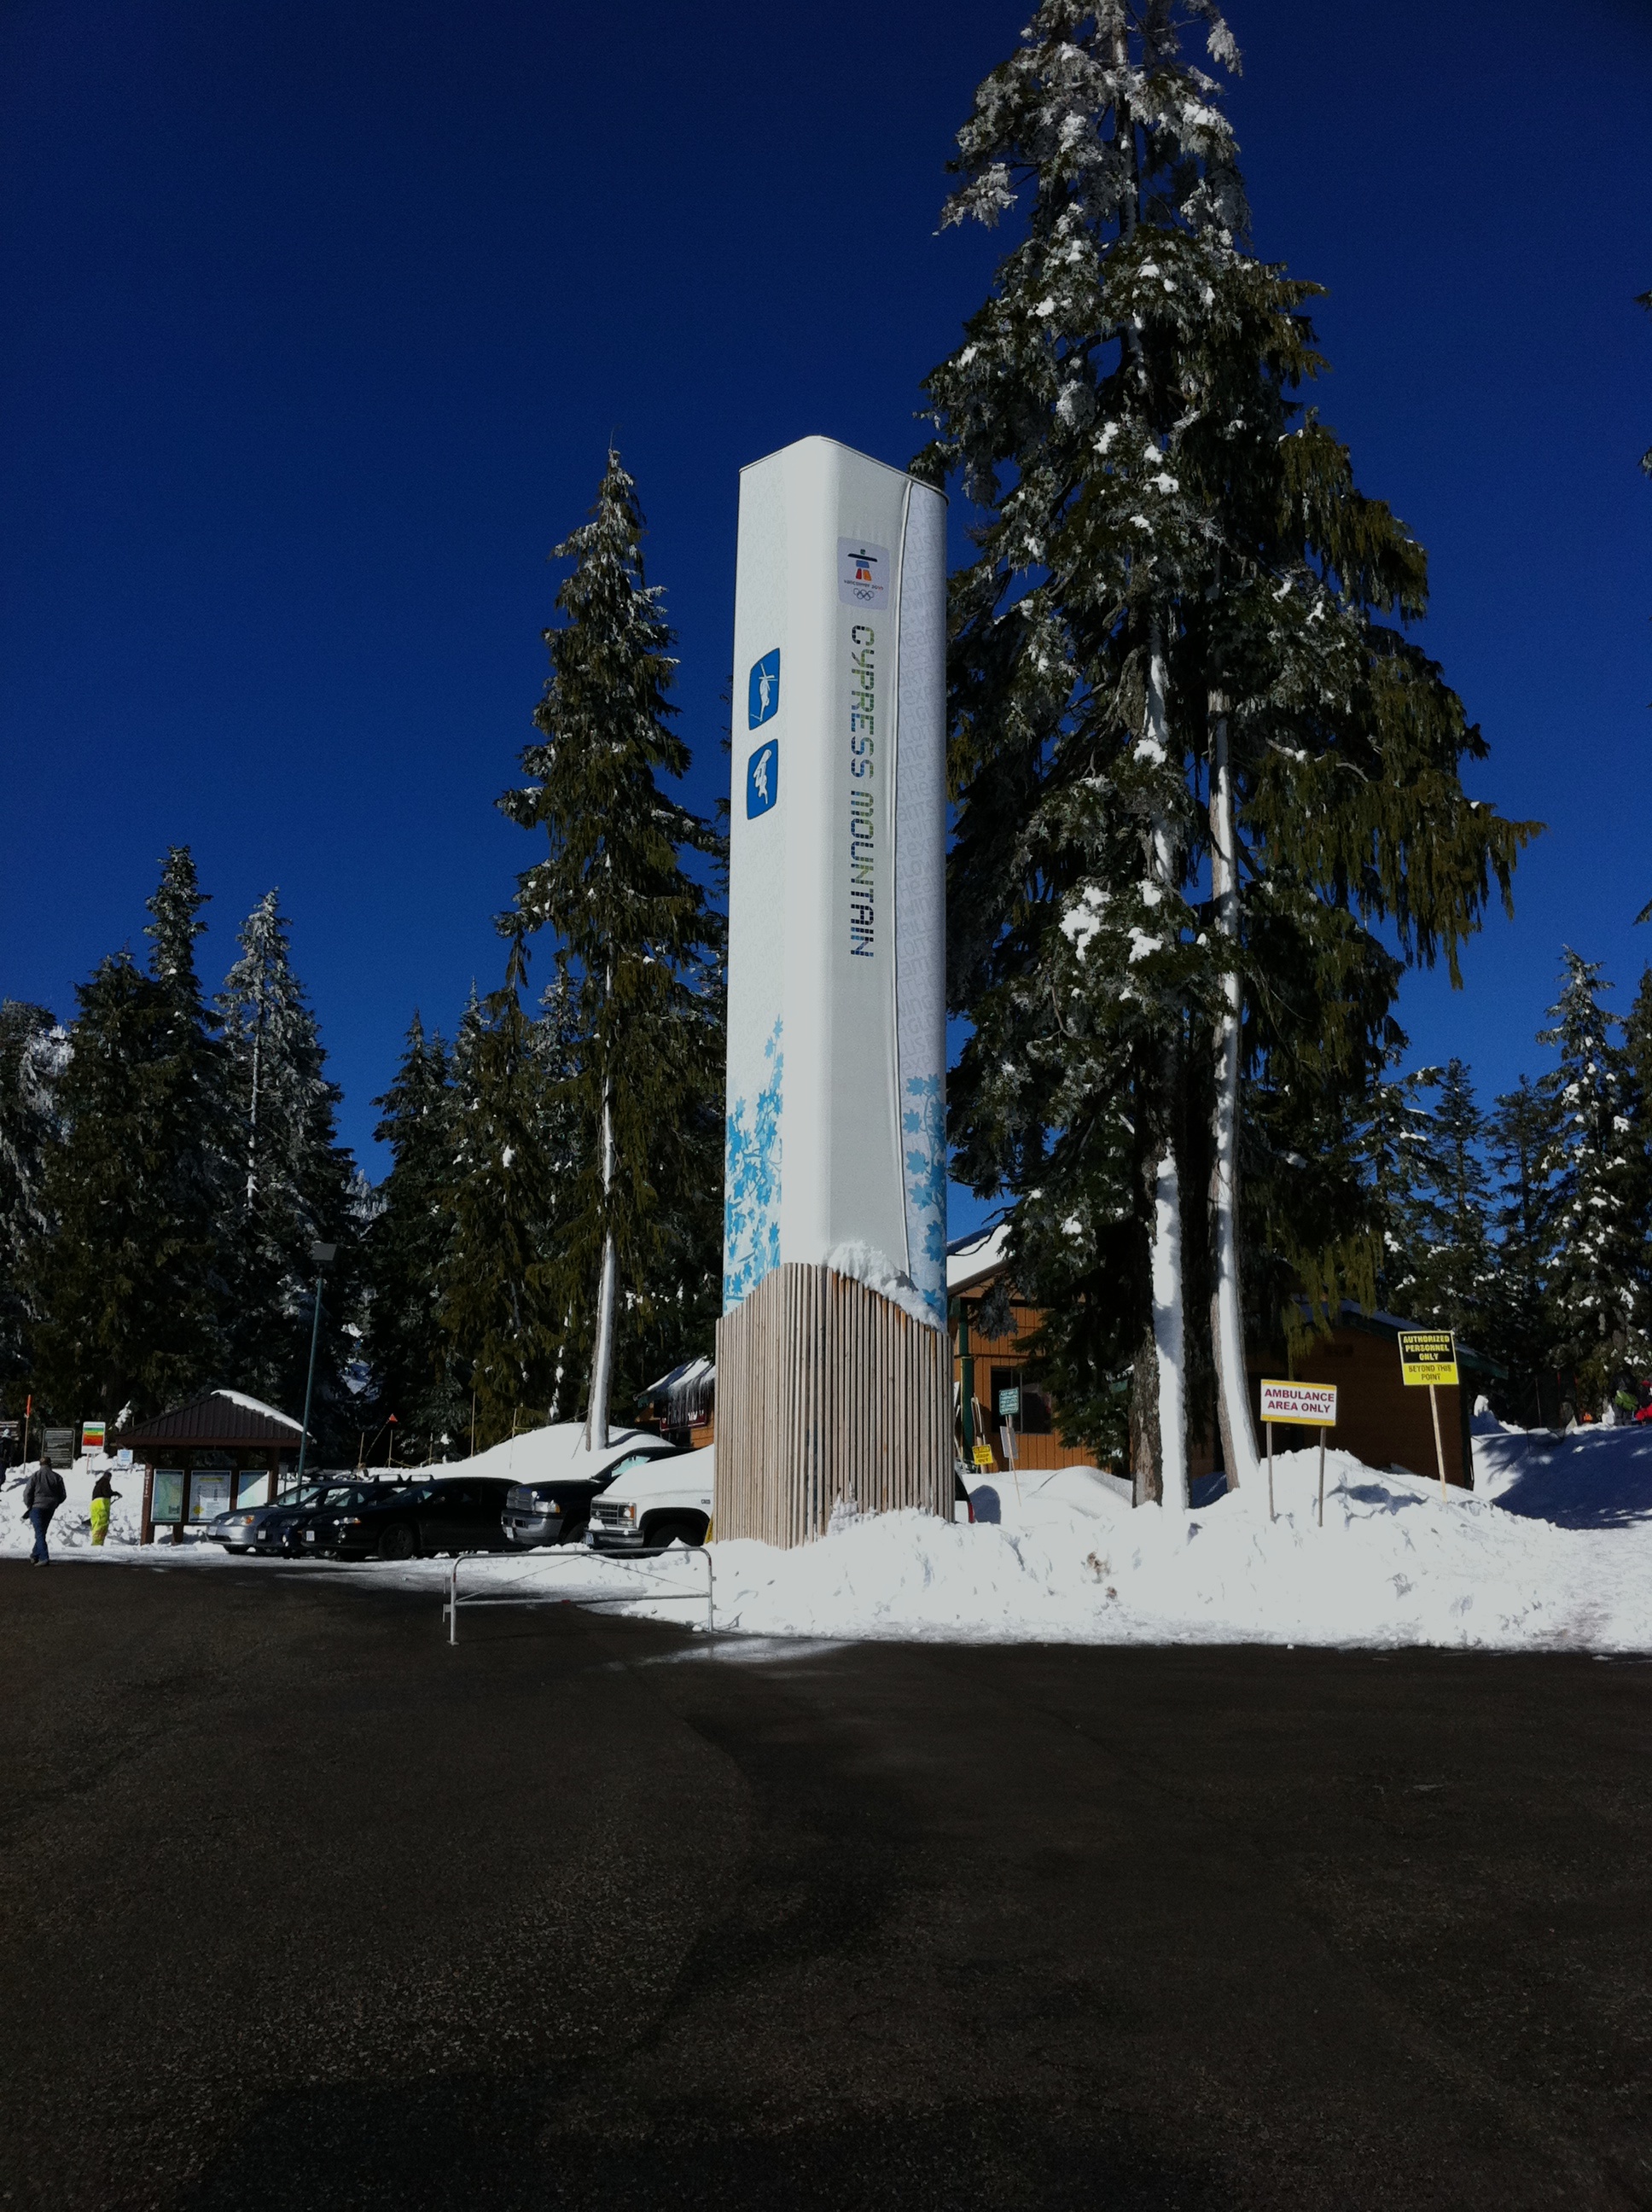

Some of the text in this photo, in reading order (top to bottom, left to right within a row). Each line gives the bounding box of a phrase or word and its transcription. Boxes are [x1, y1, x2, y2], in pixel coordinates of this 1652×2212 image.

[1405, 1344, 1450, 1353] PERSONNEL
[1265, 1388, 1335, 1402] AMBULANCE
[1267, 1400, 1330, 1412] AREA ONLY
